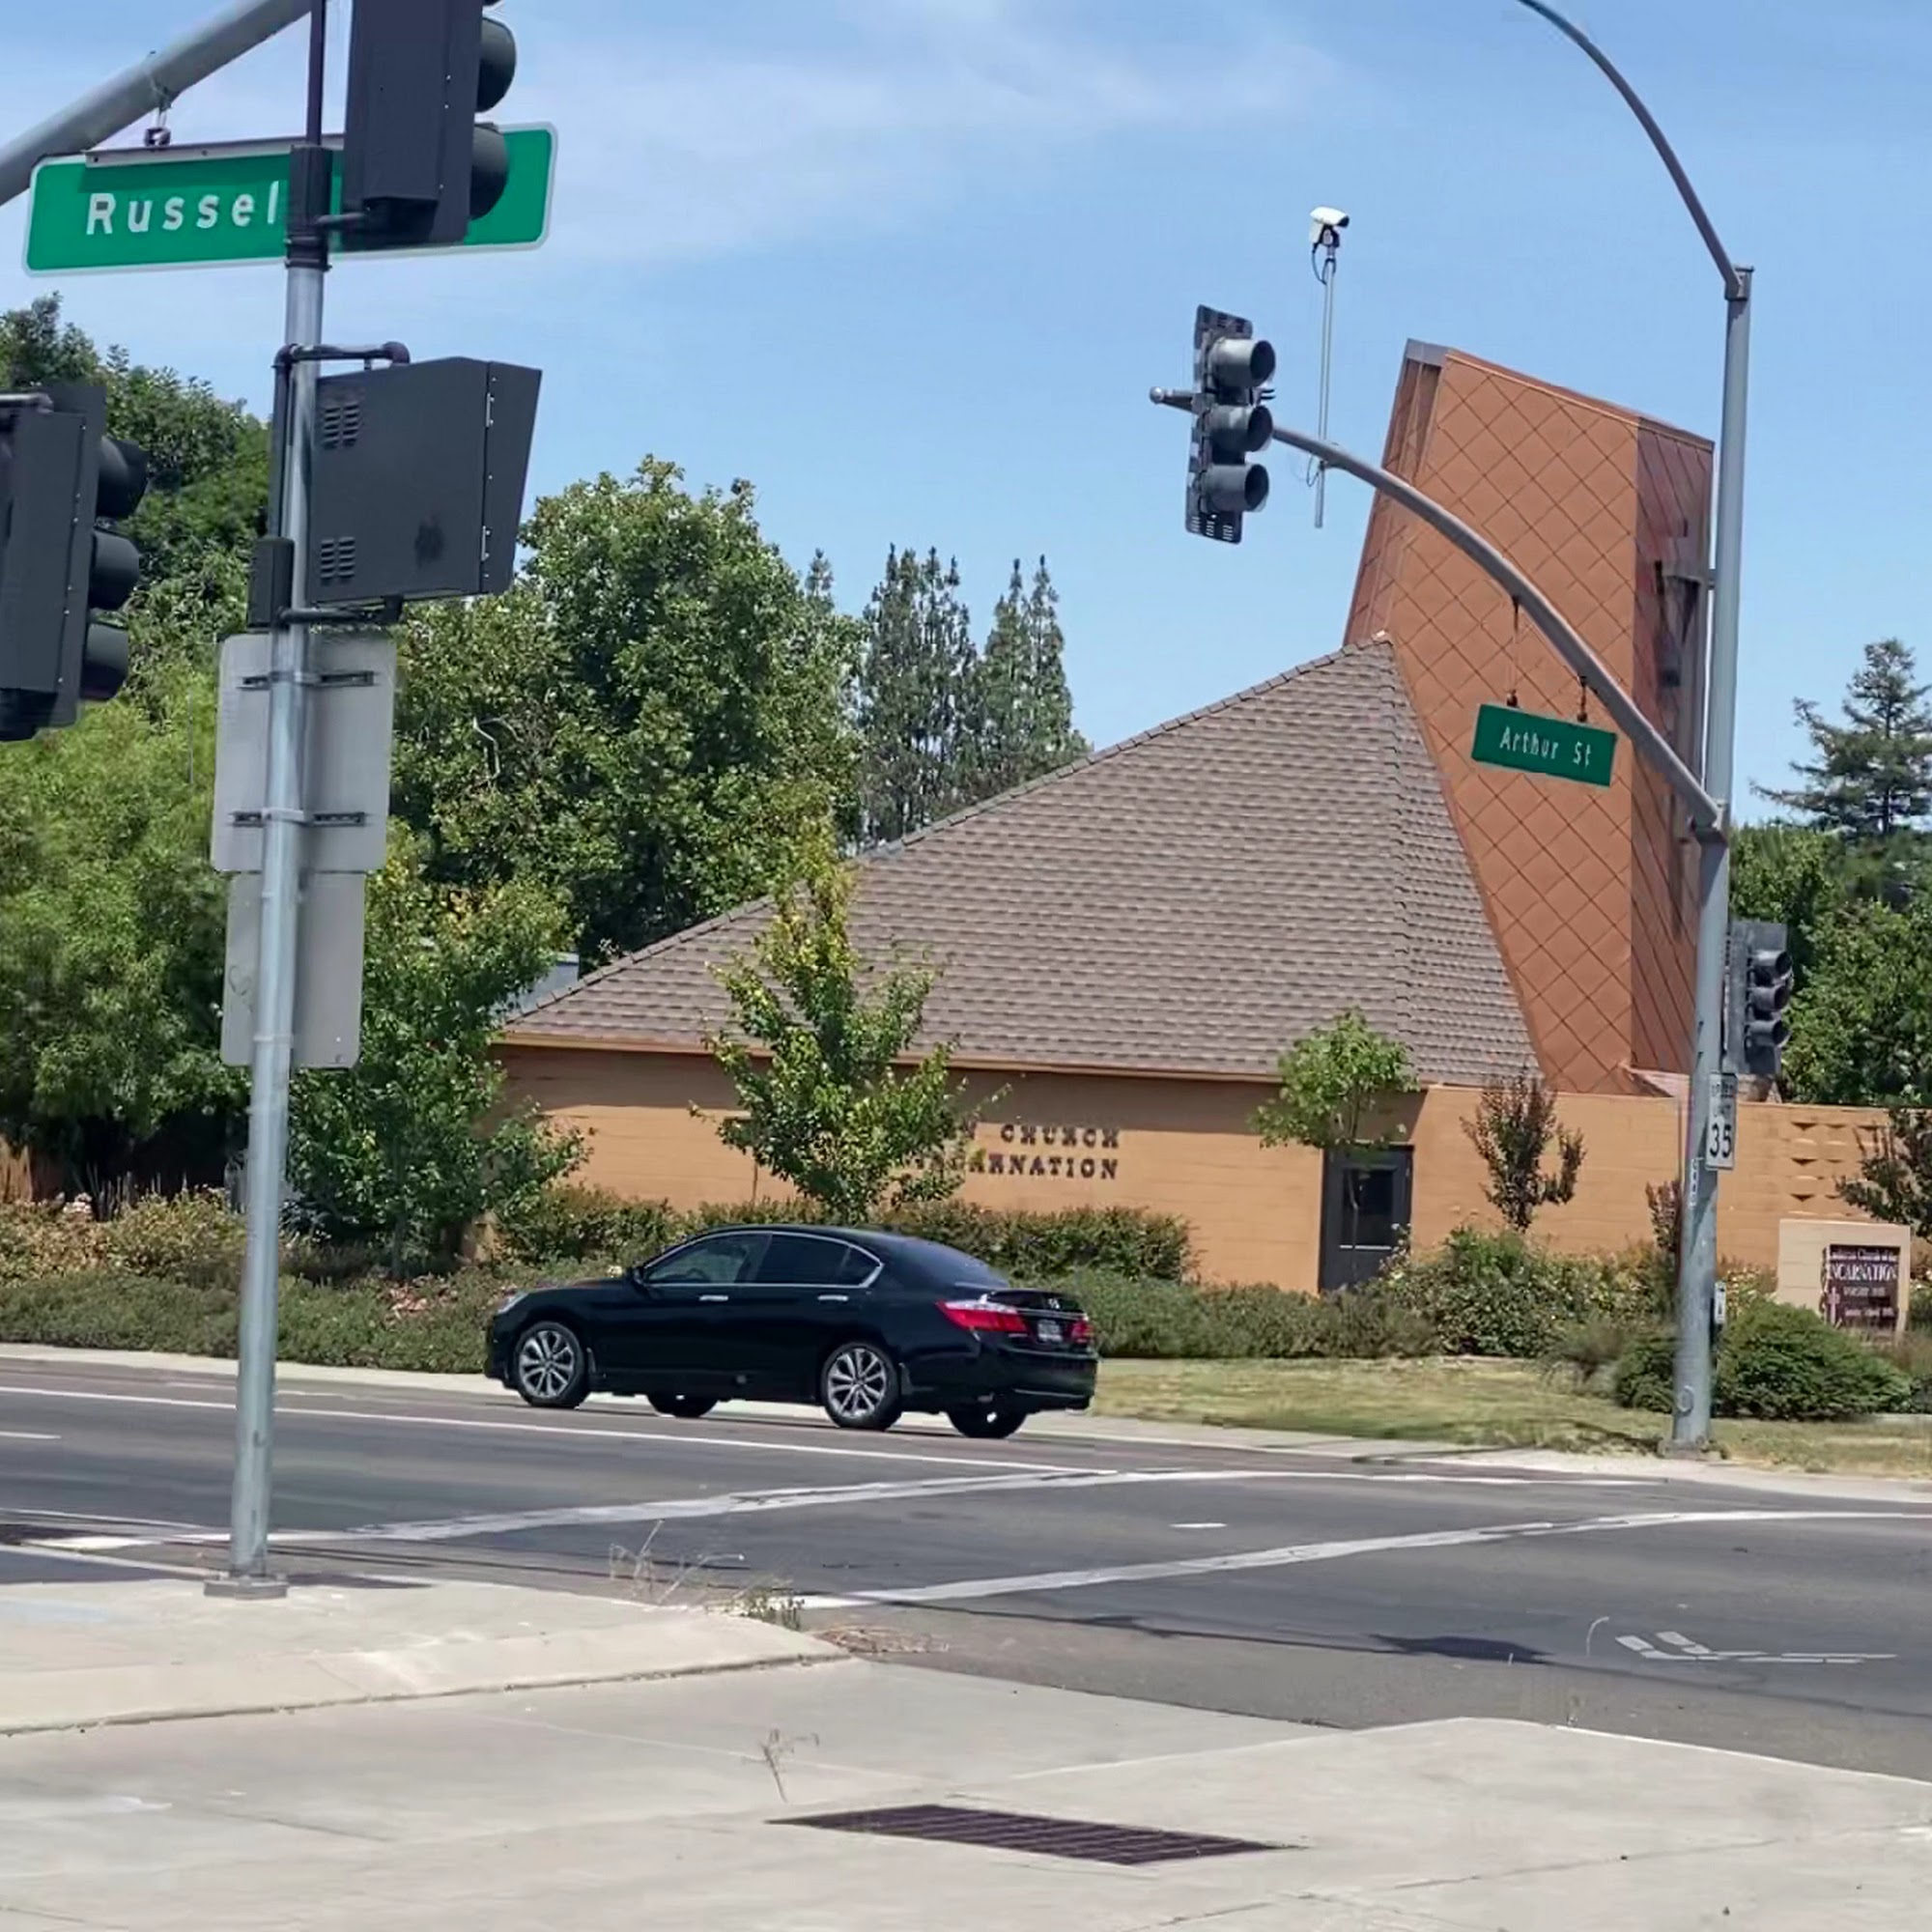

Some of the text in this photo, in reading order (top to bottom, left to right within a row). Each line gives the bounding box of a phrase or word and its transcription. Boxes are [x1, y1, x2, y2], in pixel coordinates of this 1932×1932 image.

[86, 180, 279, 236] Russel
[1499, 726, 1592, 768] Arthur St
[1001, 1123, 1120, 1149] CHURCH
[1709, 1122, 1732, 1158] 35
